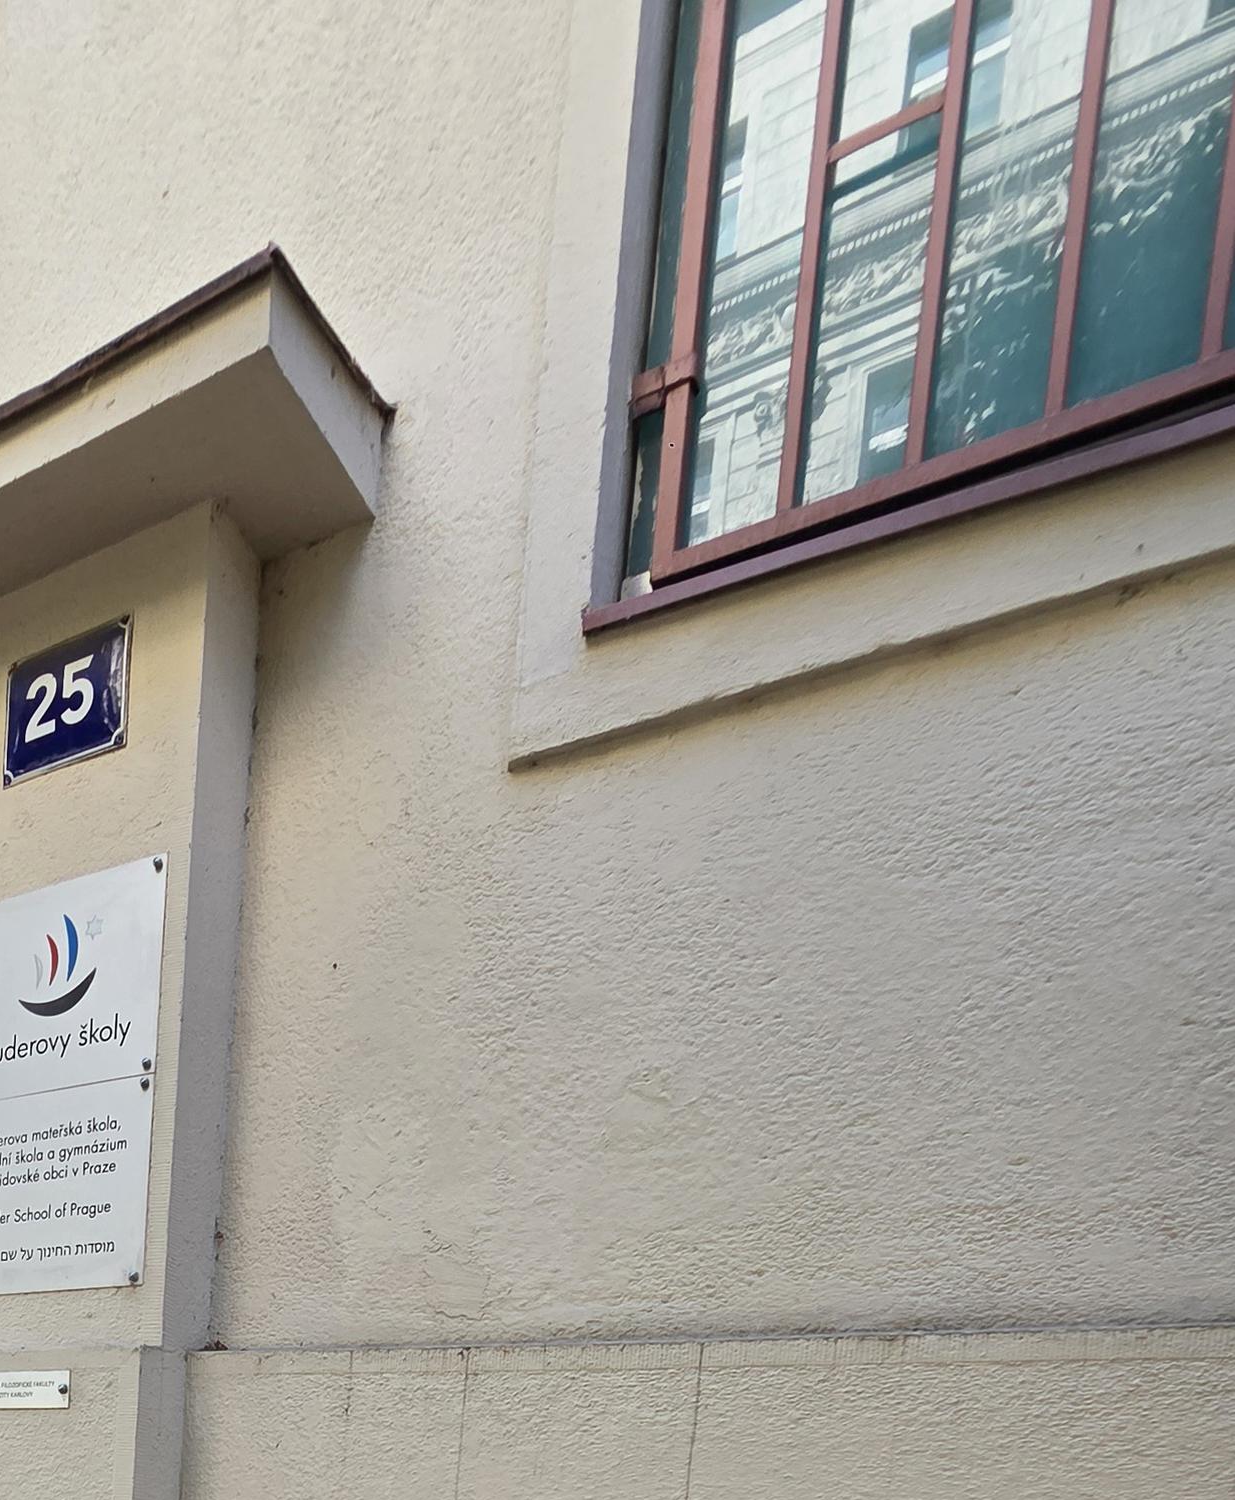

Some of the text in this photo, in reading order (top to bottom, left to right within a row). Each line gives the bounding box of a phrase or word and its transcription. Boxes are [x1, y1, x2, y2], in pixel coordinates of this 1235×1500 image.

[24, 653, 95, 743] 25
[78, 1013, 131, 1047] školy
[31, 1120, 83, 1142] mateřská
[86, 1115, 122, 1133] škola,
[15, 1147, 44, 1164] škola
[47, 1149, 56, 1160] a
[58, 1139, 128, 1162] gymnázium
[43, 1165, 69, 1181] obci
[72, 1167, 79, 1177] v
[82, 1161, 117, 1176] Praze
[13, 1203, 51, 1223] School
[54, 1202, 67, 1218] of
[70, 1202, 111, 1219] Prague
[0, 1250, 17, 1262] שם
[20, 1247, 34, 1261] על
[37, 1245, 71, 1261] החינוך
[75, 1240, 115, 1255] מוסדות
